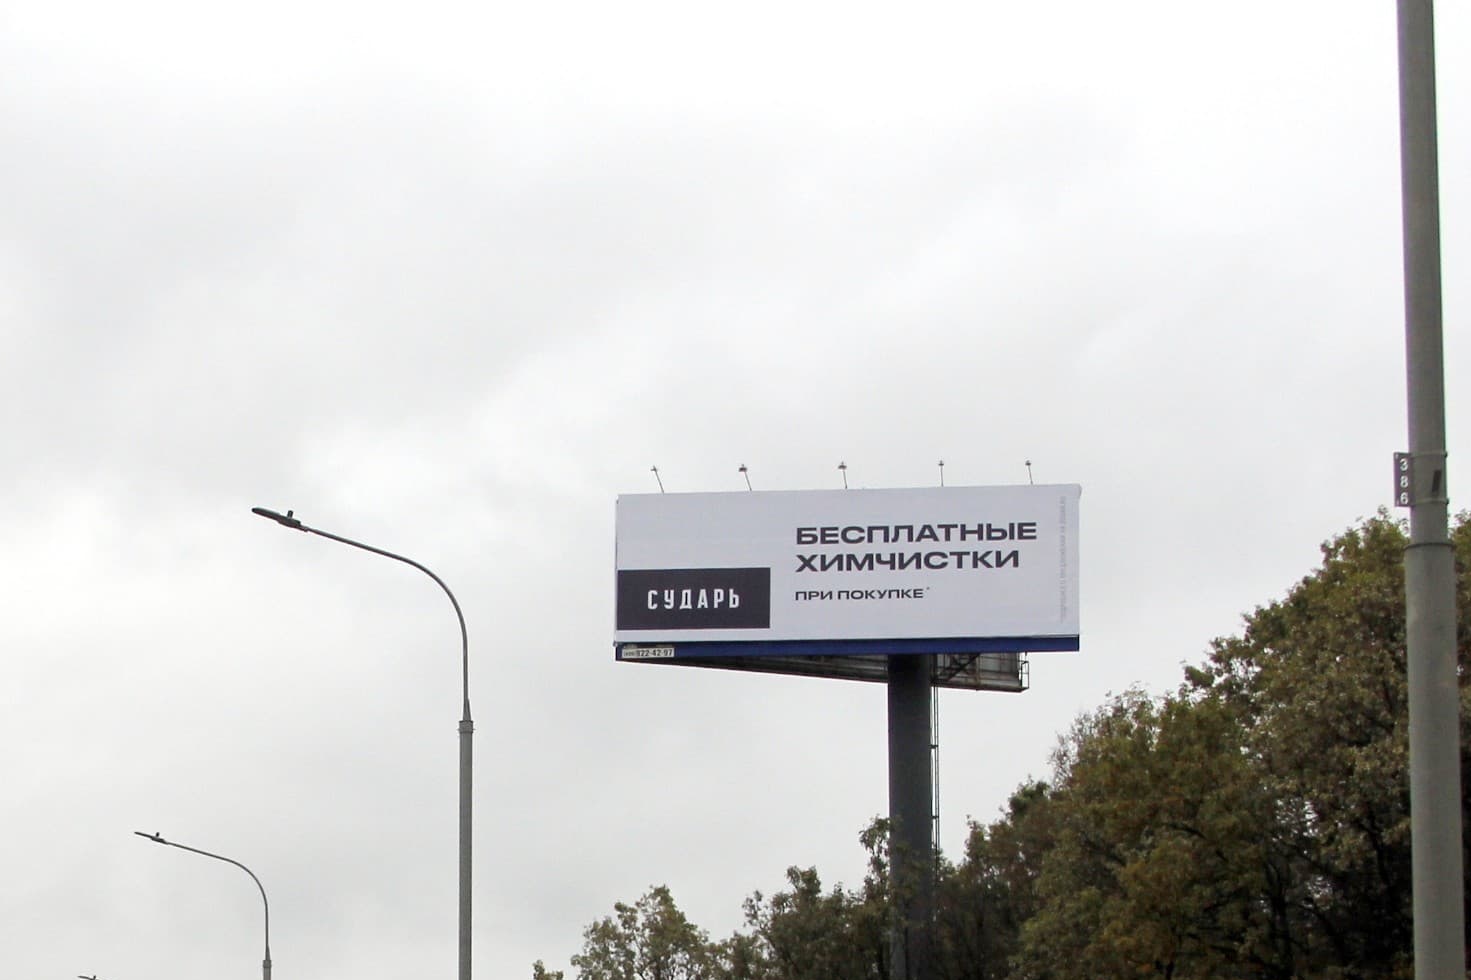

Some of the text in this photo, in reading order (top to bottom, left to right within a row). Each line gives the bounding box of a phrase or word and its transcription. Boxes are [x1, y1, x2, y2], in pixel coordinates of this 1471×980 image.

[1399, 458, 1409, 504] 386
[796, 522, 1037, 545] БЕСПЛАТНЫЕ
[795, 550, 1019, 572] ХИМЧИСТКИ
[647, 588, 740, 610] СУДАРЬ
[795, 590, 833, 601] ПРИ
